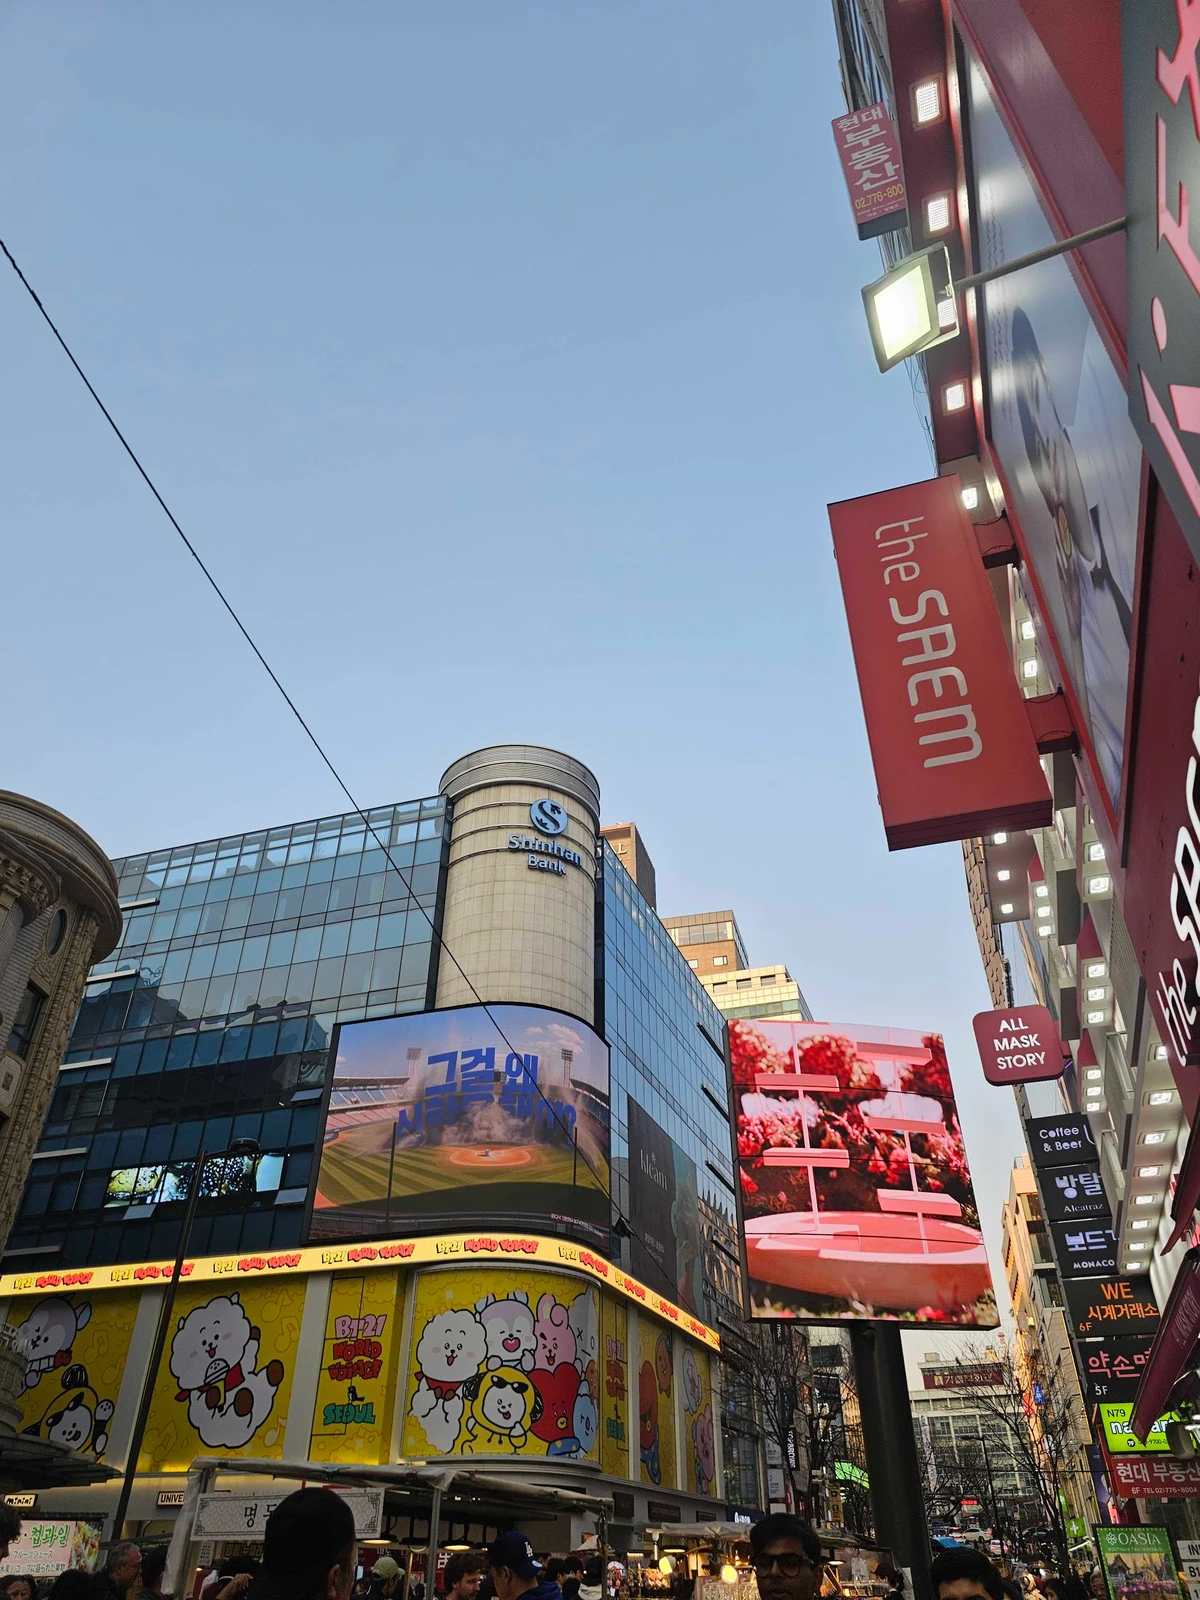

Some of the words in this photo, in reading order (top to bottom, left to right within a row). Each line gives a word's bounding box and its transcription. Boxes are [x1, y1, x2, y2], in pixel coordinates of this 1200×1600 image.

[837, 106, 883, 132] 현대
[843, 123, 899, 191] 부동산
[875, 516, 928, 585] the
[508, 833, 582, 867] Shinhan
[528, 854, 566, 876] Bank
[999, 1018, 1028, 1033] ALL
[993, 1033, 1041, 1051] MASK
[997, 1051, 1046, 1070] STORY
[425, 1047, 495, 1097] 그걸
[502, 1052, 539, 1096] 왜
[1038, 1126, 1080, 1140] Coffee
[1043, 1142, 1053, 1152] &
[1054, 1139, 1082, 1151] Beer
[1063, 1203, 1104, 1214] Alcatraz
[436, 1240, 463, 1254] BT21
[464, 1237, 499, 1253] WORLD
[499, 1239, 539, 1254] VOYAGE
[1073, 1258, 1115, 1270] MONACO
[1101, 1282, 1133, 1300] WE
[1088, 1302, 1160, 1321] 시계거래소
[335, 1314, 387, 1341] BT21
[1079, 1322, 1092, 1332] 6F
[333, 1339, 382, 1362] WORLD
[328, 1359, 383, 1381] VOYAGE
[1095, 1385, 1108, 1396] 5F
[323, 1402, 376, 1425] SEOUL
[1106, 1408, 1126, 1418] N79
[1116, 1462, 1151, 1483] 현대
[1152, 1462, 1200, 1482] 부동산
[160, 1494, 184, 1504] UNIVE
[1131, 1487, 1141, 1495] 6F
[1118, 1532, 1161, 1546] OASIA
